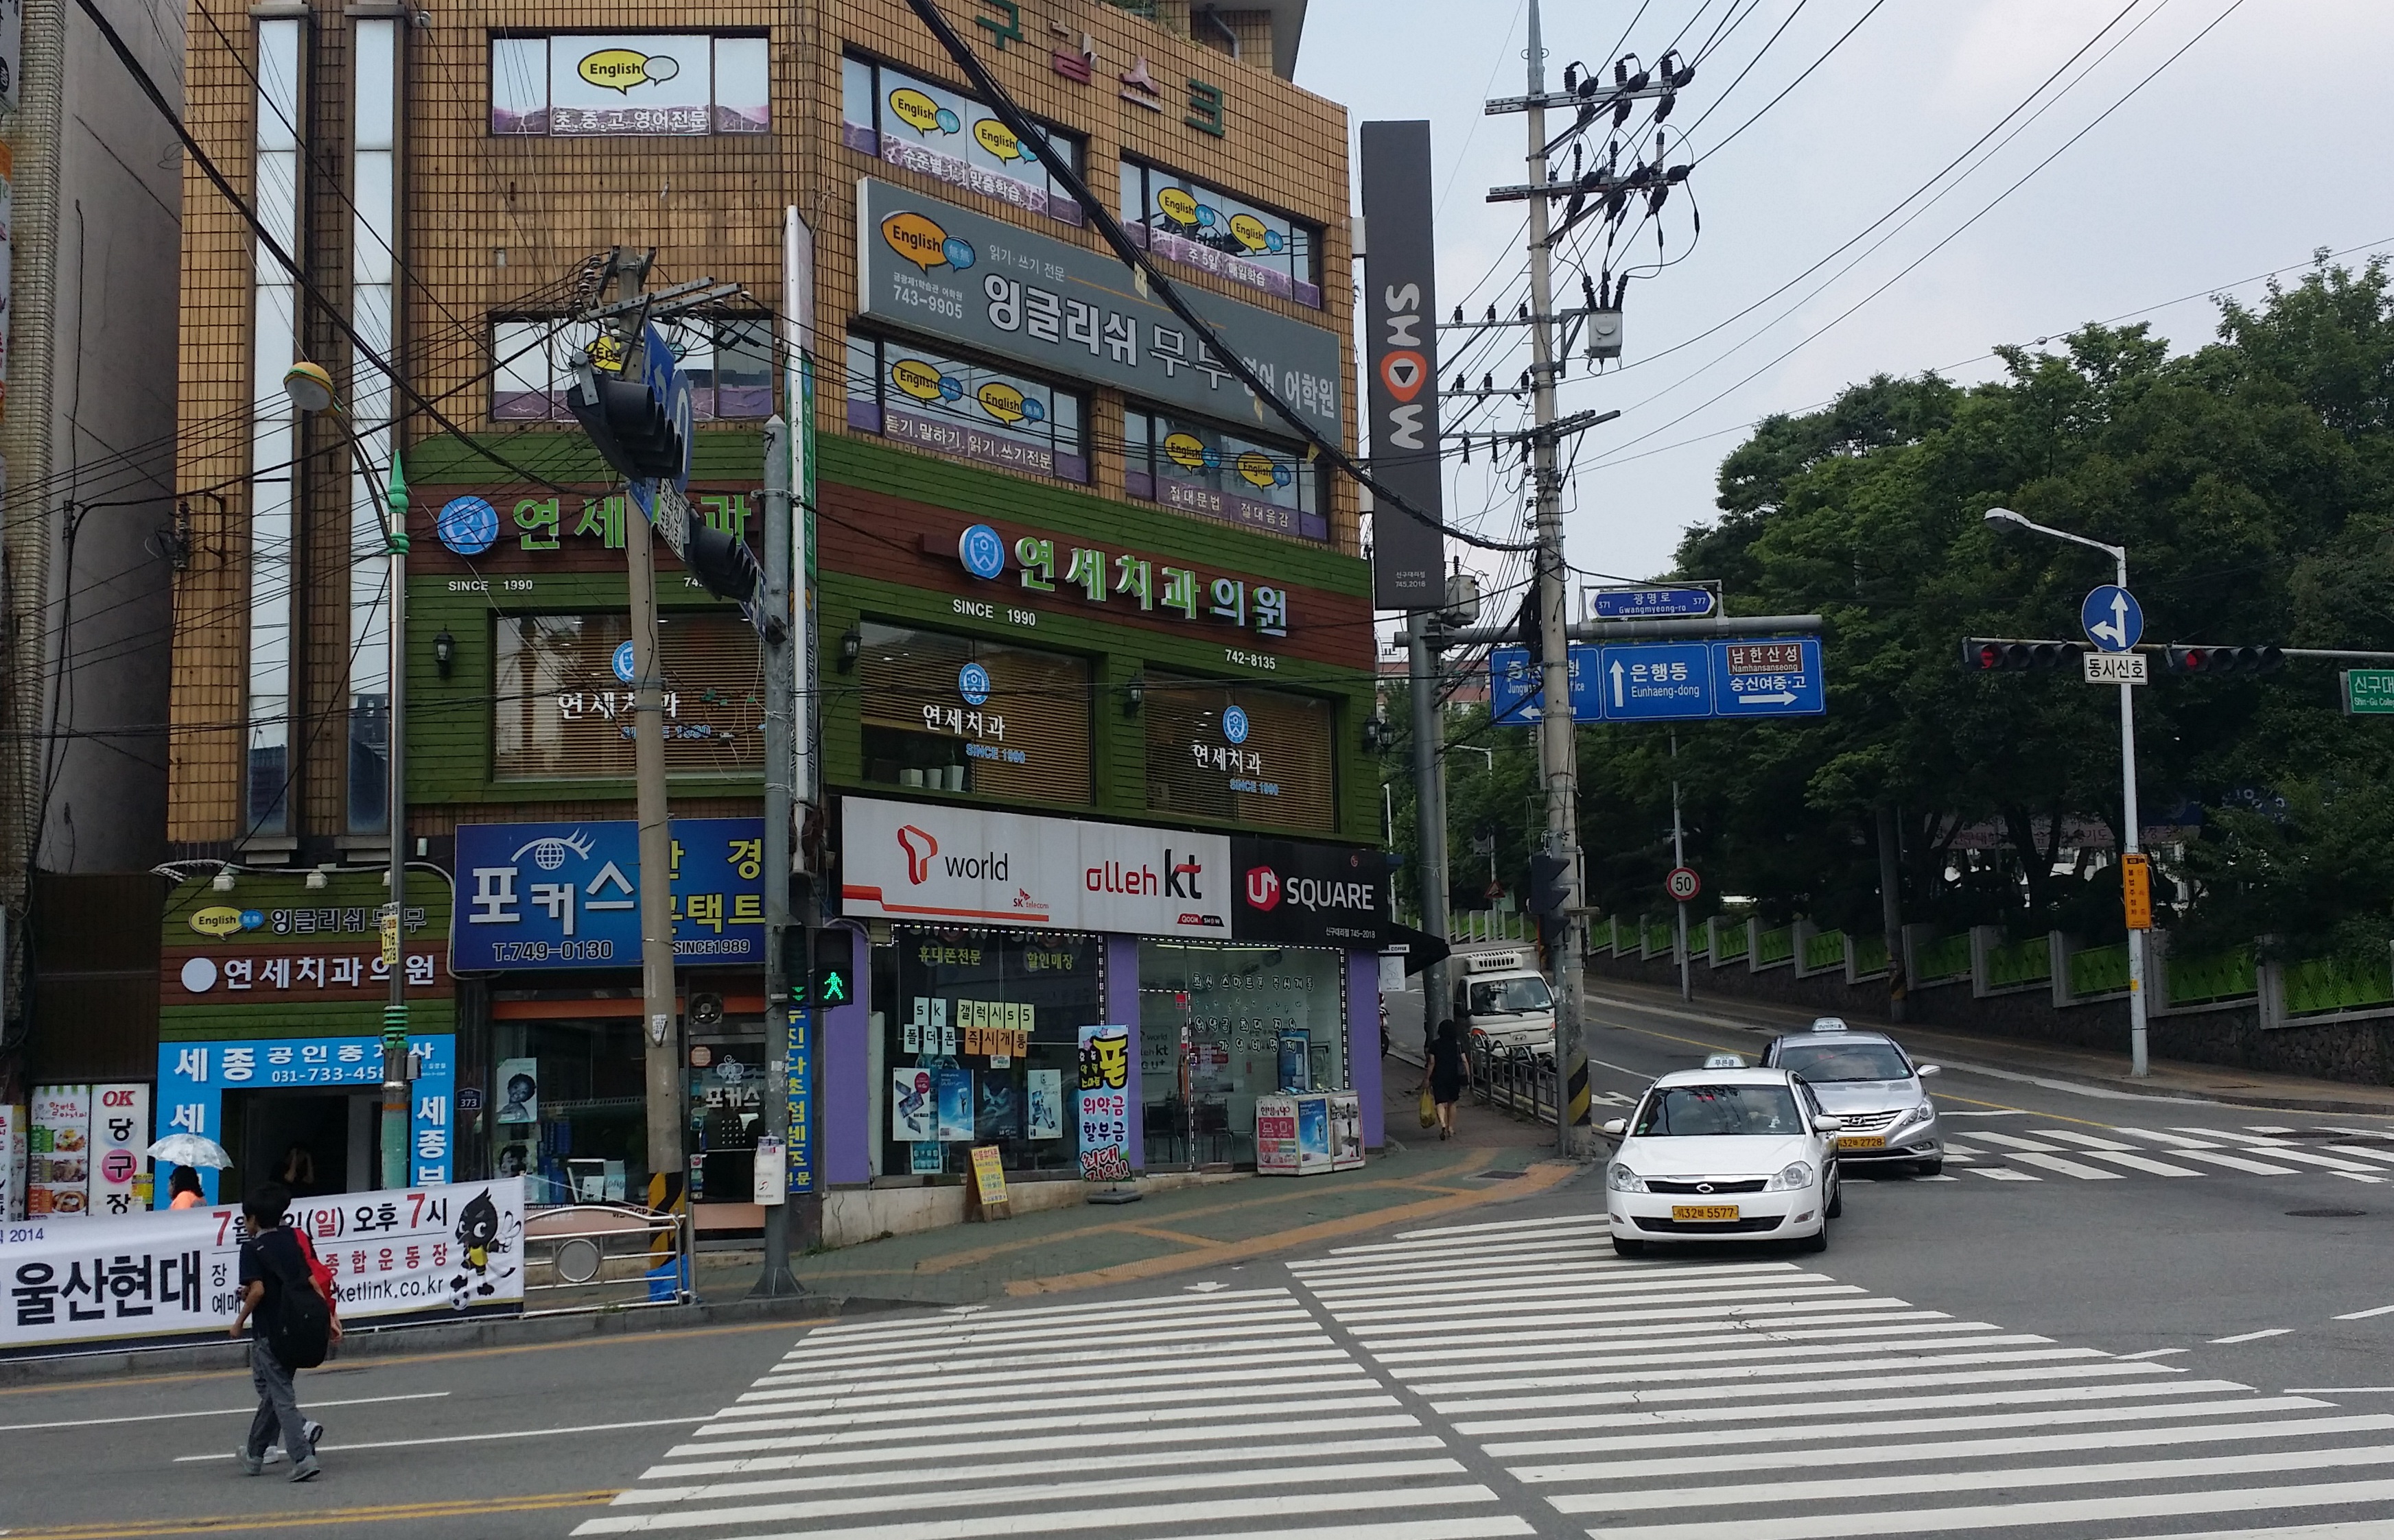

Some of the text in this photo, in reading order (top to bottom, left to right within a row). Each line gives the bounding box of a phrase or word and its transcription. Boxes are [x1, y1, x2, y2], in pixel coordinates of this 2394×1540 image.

[589, 62, 641, 78] English
[897, 97, 935, 121] English
[633, 110, 709, 131] 영어전문
[981, 128, 1016, 150] English
[1164, 196, 1195, 216] English
[893, 224, 941, 254] English
[1236, 223, 1264, 240] English
[1044, 262, 1065, 282] 전문
[893, 284, 963, 320] 743-9905
[984, 273, 1138, 368] 잉글리쉬
[1284, 370, 1335, 419] 어학원
[900, 368, 937, 391] English
[985, 392, 1020, 412] English
[1171, 441, 1201, 460] English
[1243, 461, 1271, 477] English
[1170, 484, 1221, 512] 절대문법
[513, 494, 751, 550] 연세과
[1241, 501, 1289, 529] 절대음감
[448, 579, 534, 592] SINCE 1990
[1015, 536, 1289, 638] 연세치과의원
[1598, 601, 1611, 610] 371
[1633, 592, 1671, 605] 광명로
[1692, 596, 1707, 606] 377
[952, 598, 1037, 627] SINCE 1990
[1619, 604, 1687, 615] Gwangmyeong-ro
[1225, 648, 1276, 670] 742-8135
[1732, 645, 1800, 665] 남한산성
[1630, 661, 1689, 683] 은행동
[1732, 662, 1798, 674] Namhansanseong
[2088, 659, 2145, 680] 동시신호
[1631, 684, 1700, 699] Eunhaeng-dong
[620, 725, 670, 740] SIE
[923, 704, 1006, 742] 연세치과
[965, 743, 1026, 764] SINCE 1990
[1193, 744, 1262, 777] 연세치과
[1230, 778, 1256, 794] SINCE
[945, 851, 1009, 882] world
[1085, 848, 1202, 900] olleh kt
[1287, 877, 1375, 912] SQUARE
[1675, 877, 1692, 892] 50
[469, 860, 635, 936] 포커스
[1013, 897, 1049, 910] SK telecom
[199, 915, 237, 927] English
[271, 908, 366, 934] 잉글리쉬
[1350, 928, 1376, 939] 745-2018
[492, 940, 613, 962] T.749-0130
[672, 938, 751, 956] SINCE1989
[918, 945, 982, 966] 휴대폰전문
[1028, 951, 1075, 970] 할인매장
[1193, 973, 1314, 992] 최신 스마트폰 즉시개통
[1195, 1016, 1230, 1032] 위약금
[1239, 1017, 1263, 1032] 최대
[906, 1029, 955, 1047] 폴더폰
[967, 1030, 1026, 1050] 즉시개통
[1155, 1043, 1169, 1056] kt
[174, 1046, 256, 1082] 세종
[102, 1090, 136, 1107] OK
[460, 1098, 478, 1107] 373
[705, 1086, 761, 1108] 포커스
[1083, 1095, 1125, 1116] 위약금
[1083, 1121, 1126, 1143] 할부금
[1859, 1138, 1882, 1147] 2728
[106, 1117, 134, 1215] 당구장
[1082, 1146, 1118, 1168] 최대
[1086, 1161, 1129, 1181] 지원!
[353, 1202, 399, 1233] 오후
[406, 1192, 449, 1229] 7시
[1707, 1207, 1734, 1218] 5577
[10, 1227, 45, 1243] 2014
[12, 1250, 202, 1326] 울산현대
